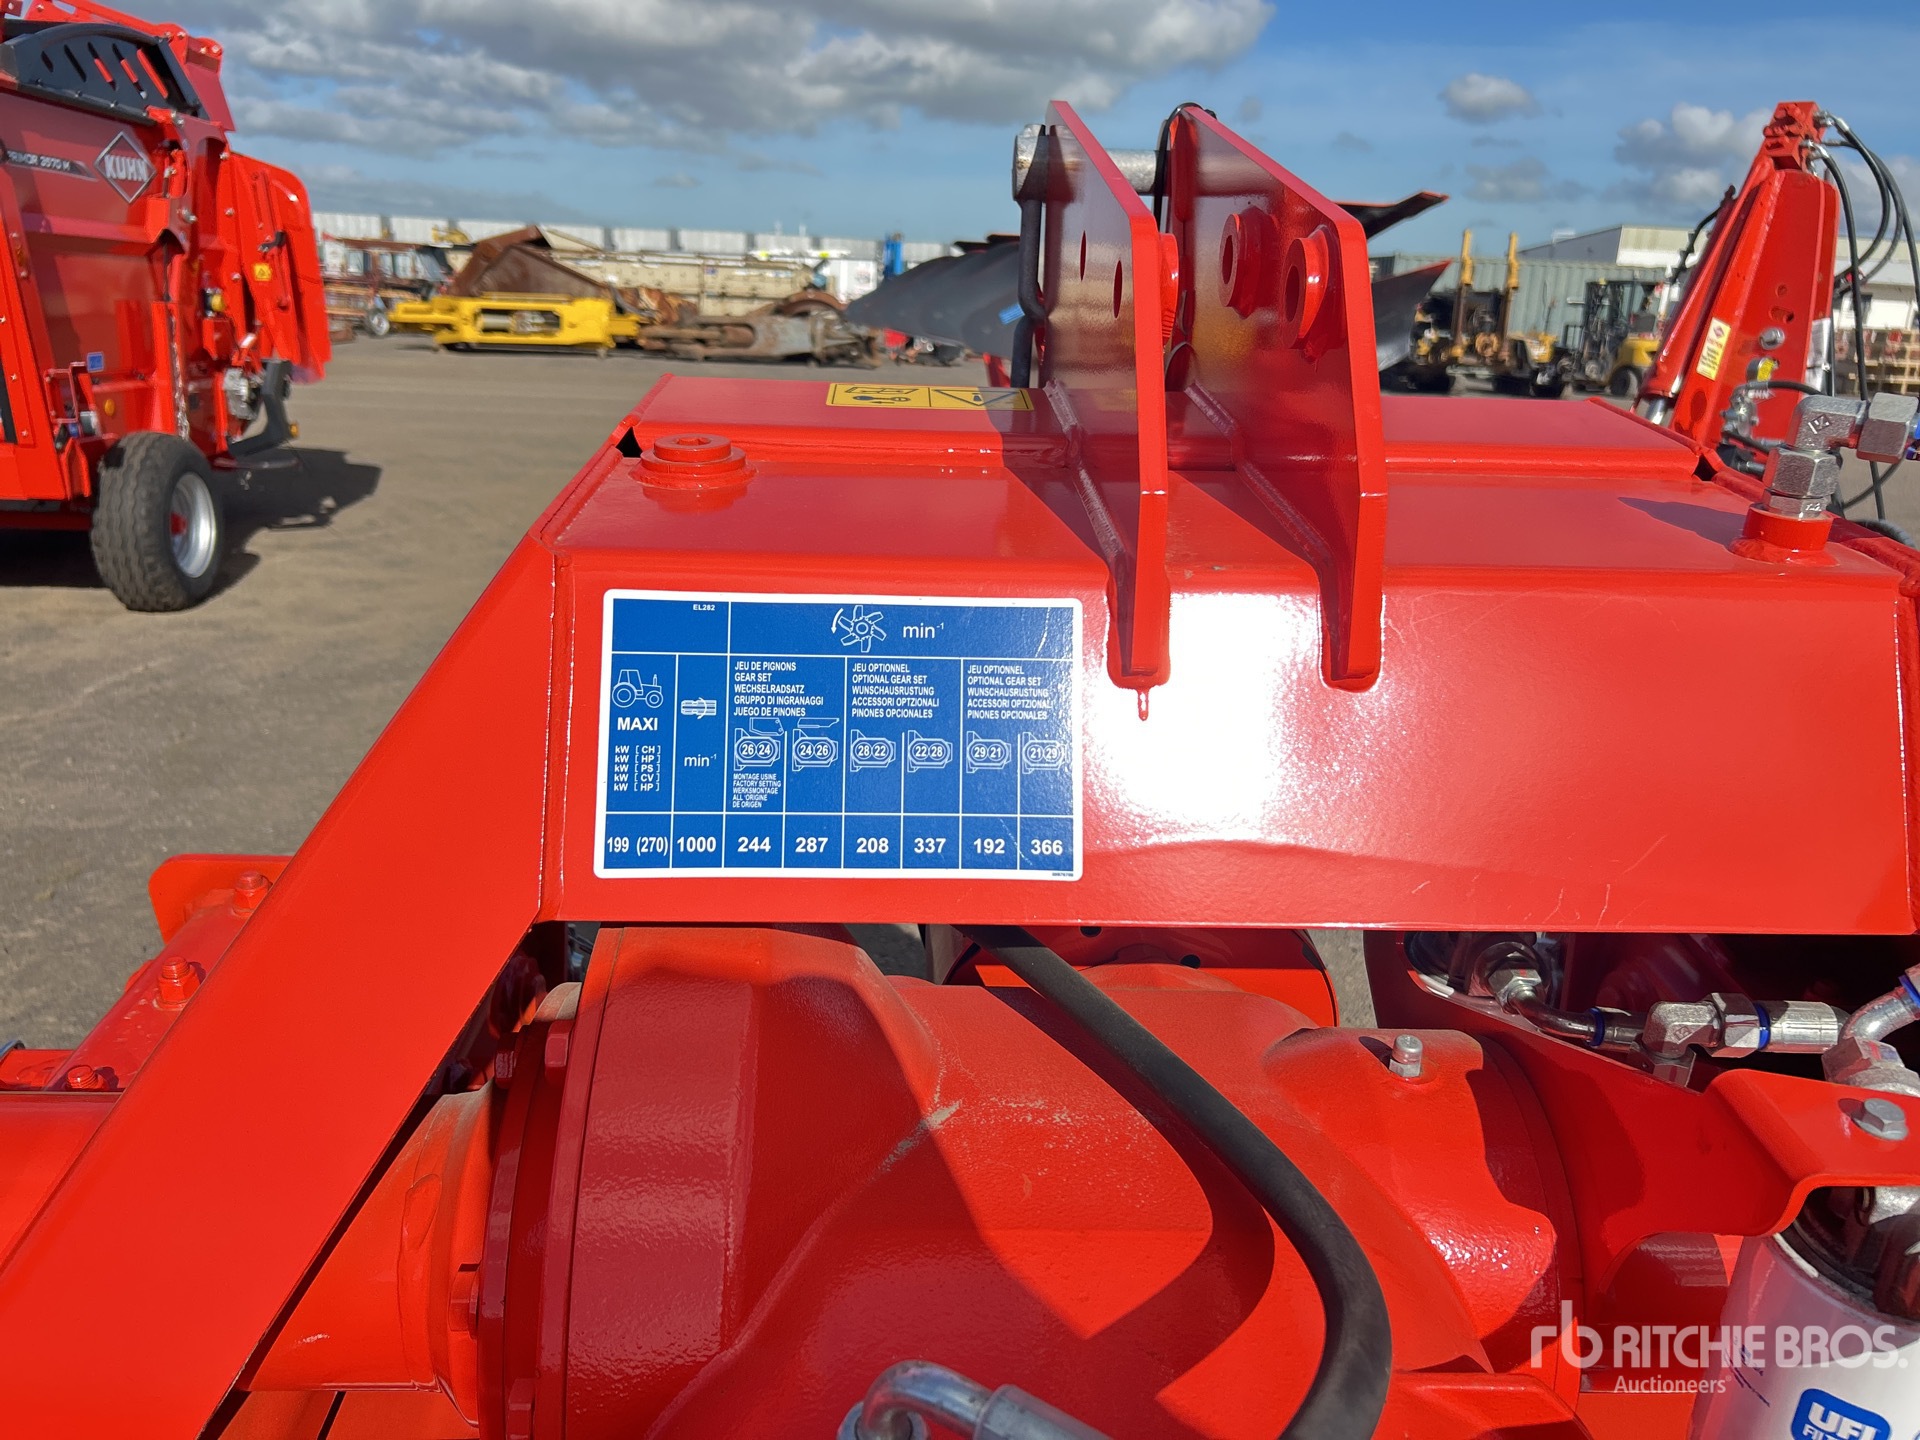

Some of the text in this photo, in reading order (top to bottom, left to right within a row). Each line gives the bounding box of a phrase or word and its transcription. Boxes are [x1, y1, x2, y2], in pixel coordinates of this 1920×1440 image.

[104, 155, 148, 181] KUHN
[735, 661, 796, 671] JEU DE PIGNONS
[853, 663, 910, 673] JEU OPTIONNEL
[968, 665, 1025, 674] JEU OPTIONNEL
[735, 673, 772, 682] GEAR SET
[852, 674, 927, 684] OPTIONAL GEAR SET
[968, 676, 1042, 686] OPTIONAL GEAR SET
[735, 684, 804, 693] WECHSELRADSATZ
[852, 686, 934, 695] WUNSCHAUSRUSTUNG
[967, 688, 1050, 697] WUNSCHAUSRUSTUNG
[734, 695, 823, 705] GRUPPO DI INGRANAGGI
[852, 697, 939, 707] ACCESSORI OPTZIONALI
[967, 699, 1055, 709] ACCESSORI OPTZIONALI
[734, 707, 805, 716] JUEGO DE PINONES
[852, 708, 933, 718] PINONES OPCIONALES
[967, 710, 1048, 720] PINONES OPCIONALES
[618, 717, 657, 730] MAXI
[742, 745, 771, 755] 26 24
[800, 745, 829, 756] 24 26
[858, 746, 886, 756] 28 22
[915, 746, 943, 757] 22 28
[974, 747, 1001, 758] 29 21
[1031, 748, 1057, 758] 21 29
[615, 755, 629, 763] kW
[615, 764, 628, 772] kW
[614, 783, 628, 791] kW
[607, 836, 668, 856] 199 (270)
[677, 837, 716, 852] 1000
[738, 837, 771, 852] 244
[796, 837, 828, 852] 287
[857, 838, 889, 853] 208
[914, 838, 946, 853] 337
[974, 838, 1005, 854] 192
[1031, 839, 1063, 855] 366
[1808, 1402, 1877, 1440] UFI
